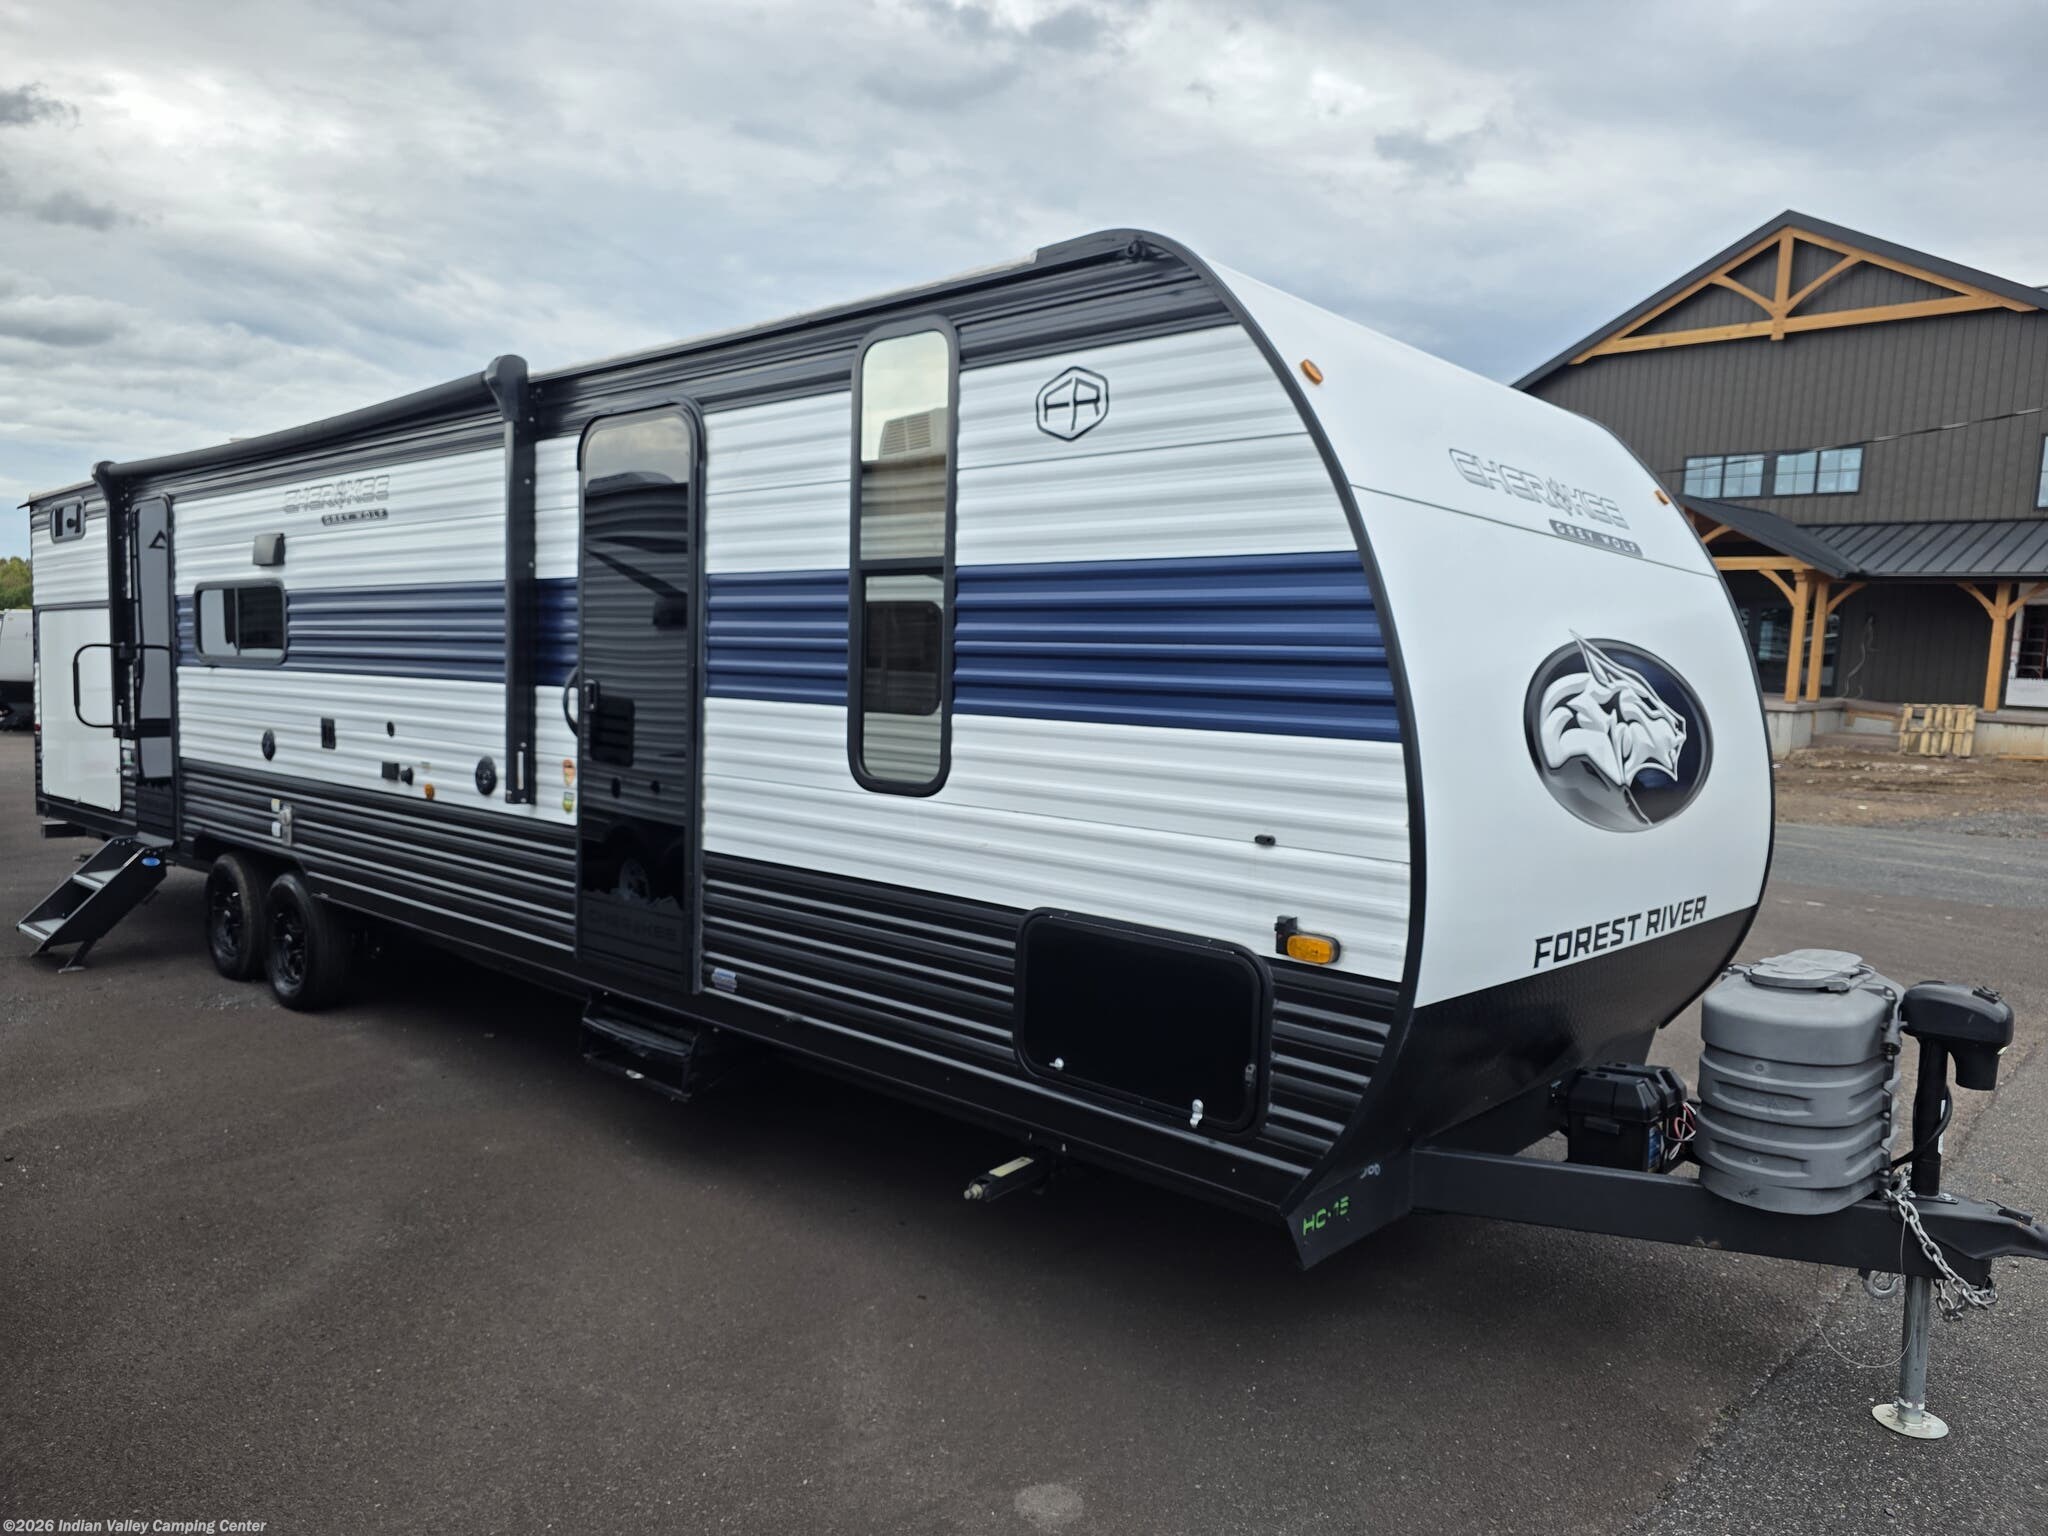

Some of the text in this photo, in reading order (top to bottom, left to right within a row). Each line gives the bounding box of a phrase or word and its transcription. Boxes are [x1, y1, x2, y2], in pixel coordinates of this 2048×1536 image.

[1449, 447, 1631, 531] CHEROKEE
[1533, 895, 1708, 969] FOREST RIVER
